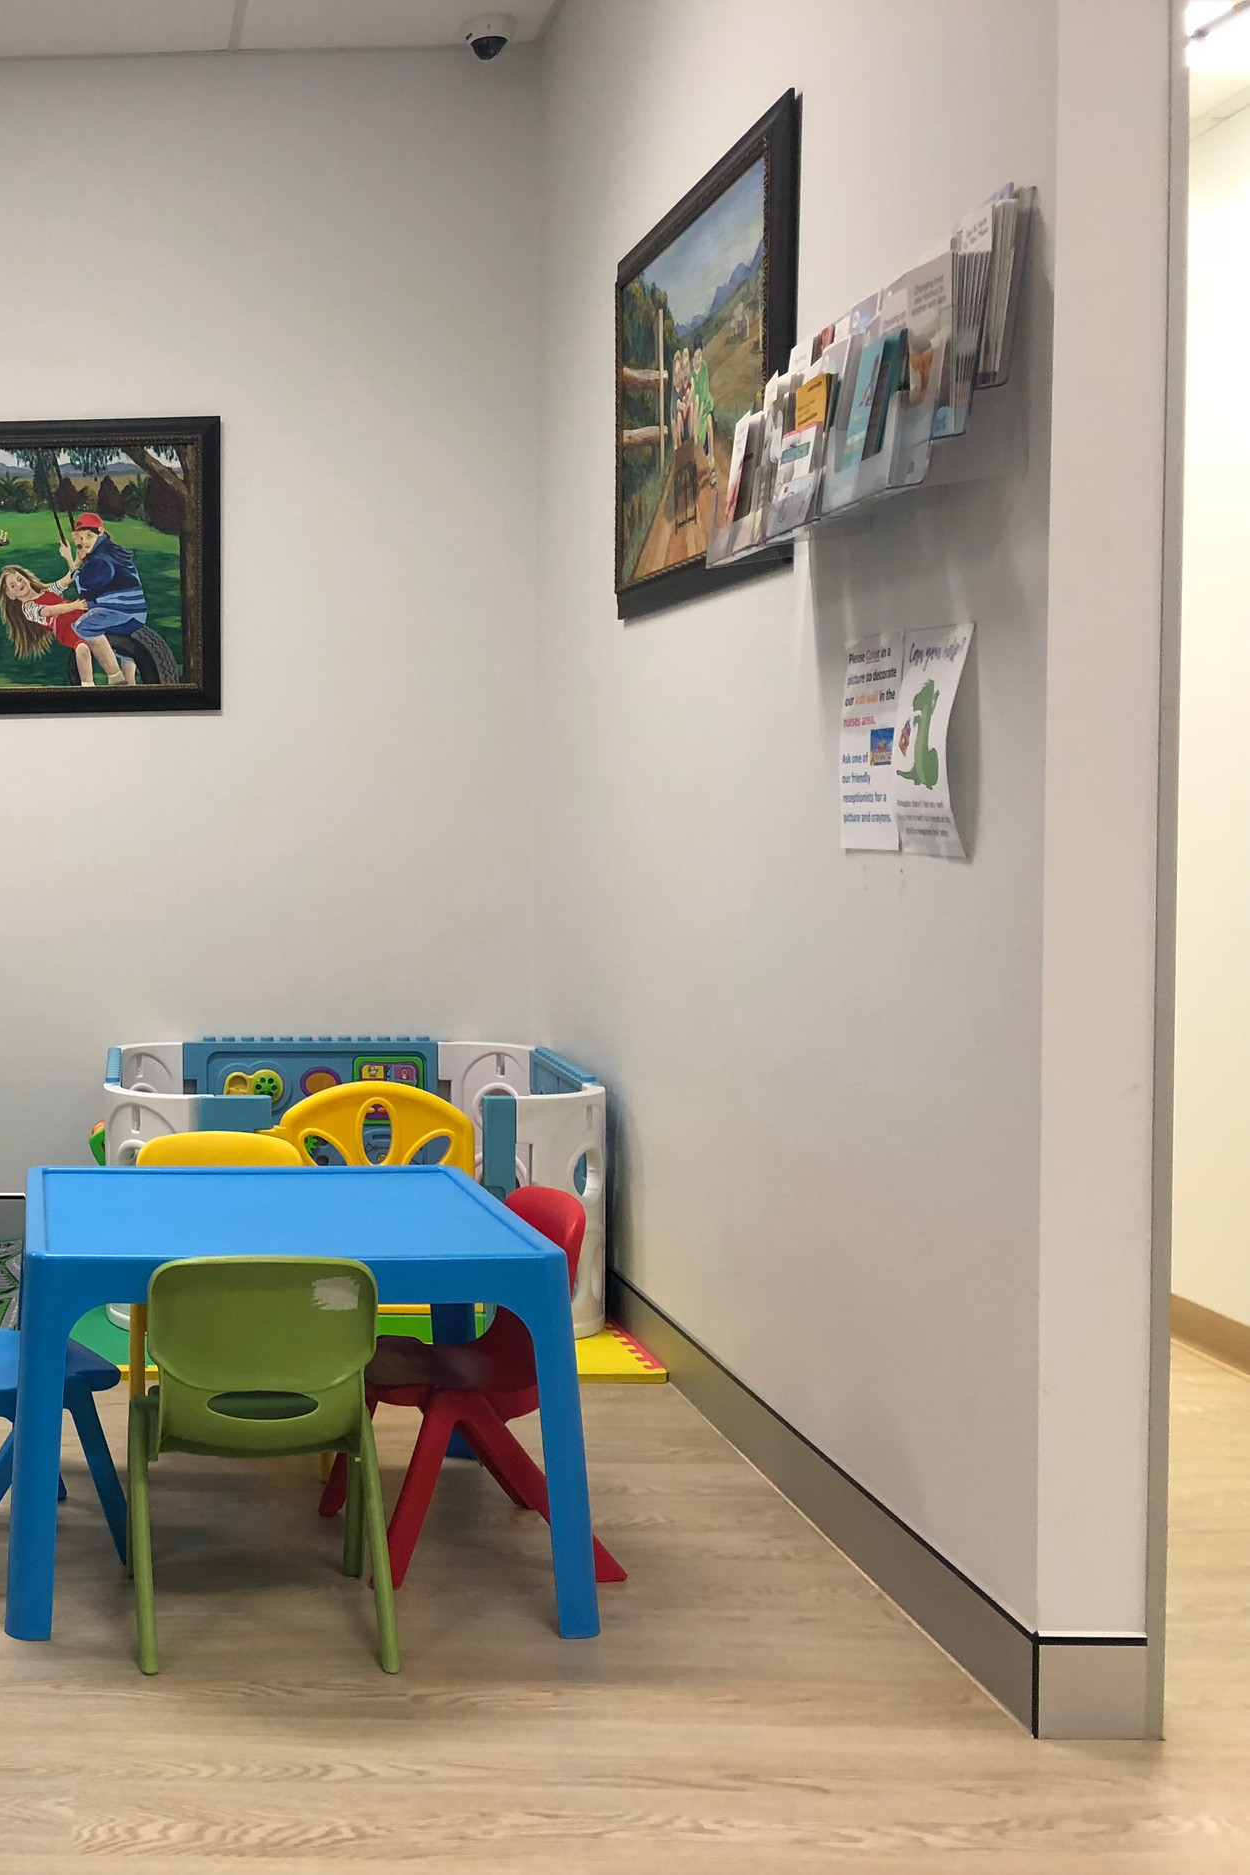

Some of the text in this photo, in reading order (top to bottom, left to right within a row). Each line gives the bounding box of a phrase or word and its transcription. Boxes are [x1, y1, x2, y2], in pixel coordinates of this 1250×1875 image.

[848, 653, 865, 665] Please
[880, 647, 887, 658] in
[887, 648, 892, 657] a
[847, 667, 897, 688] picture to decorate
[844, 697, 854, 707] our
[879, 690, 885, 702] in
[886, 688, 896, 700] the
[843, 717, 861, 729] nurses
[842, 754, 850, 764] Ask
[851, 755, 862, 764] one
[862, 752, 868, 763] of
[842, 772, 871, 785] our friendly
[842, 792, 875, 804] receptionists
[843, 812, 861, 824] picture
[861, 812, 871, 823] and
